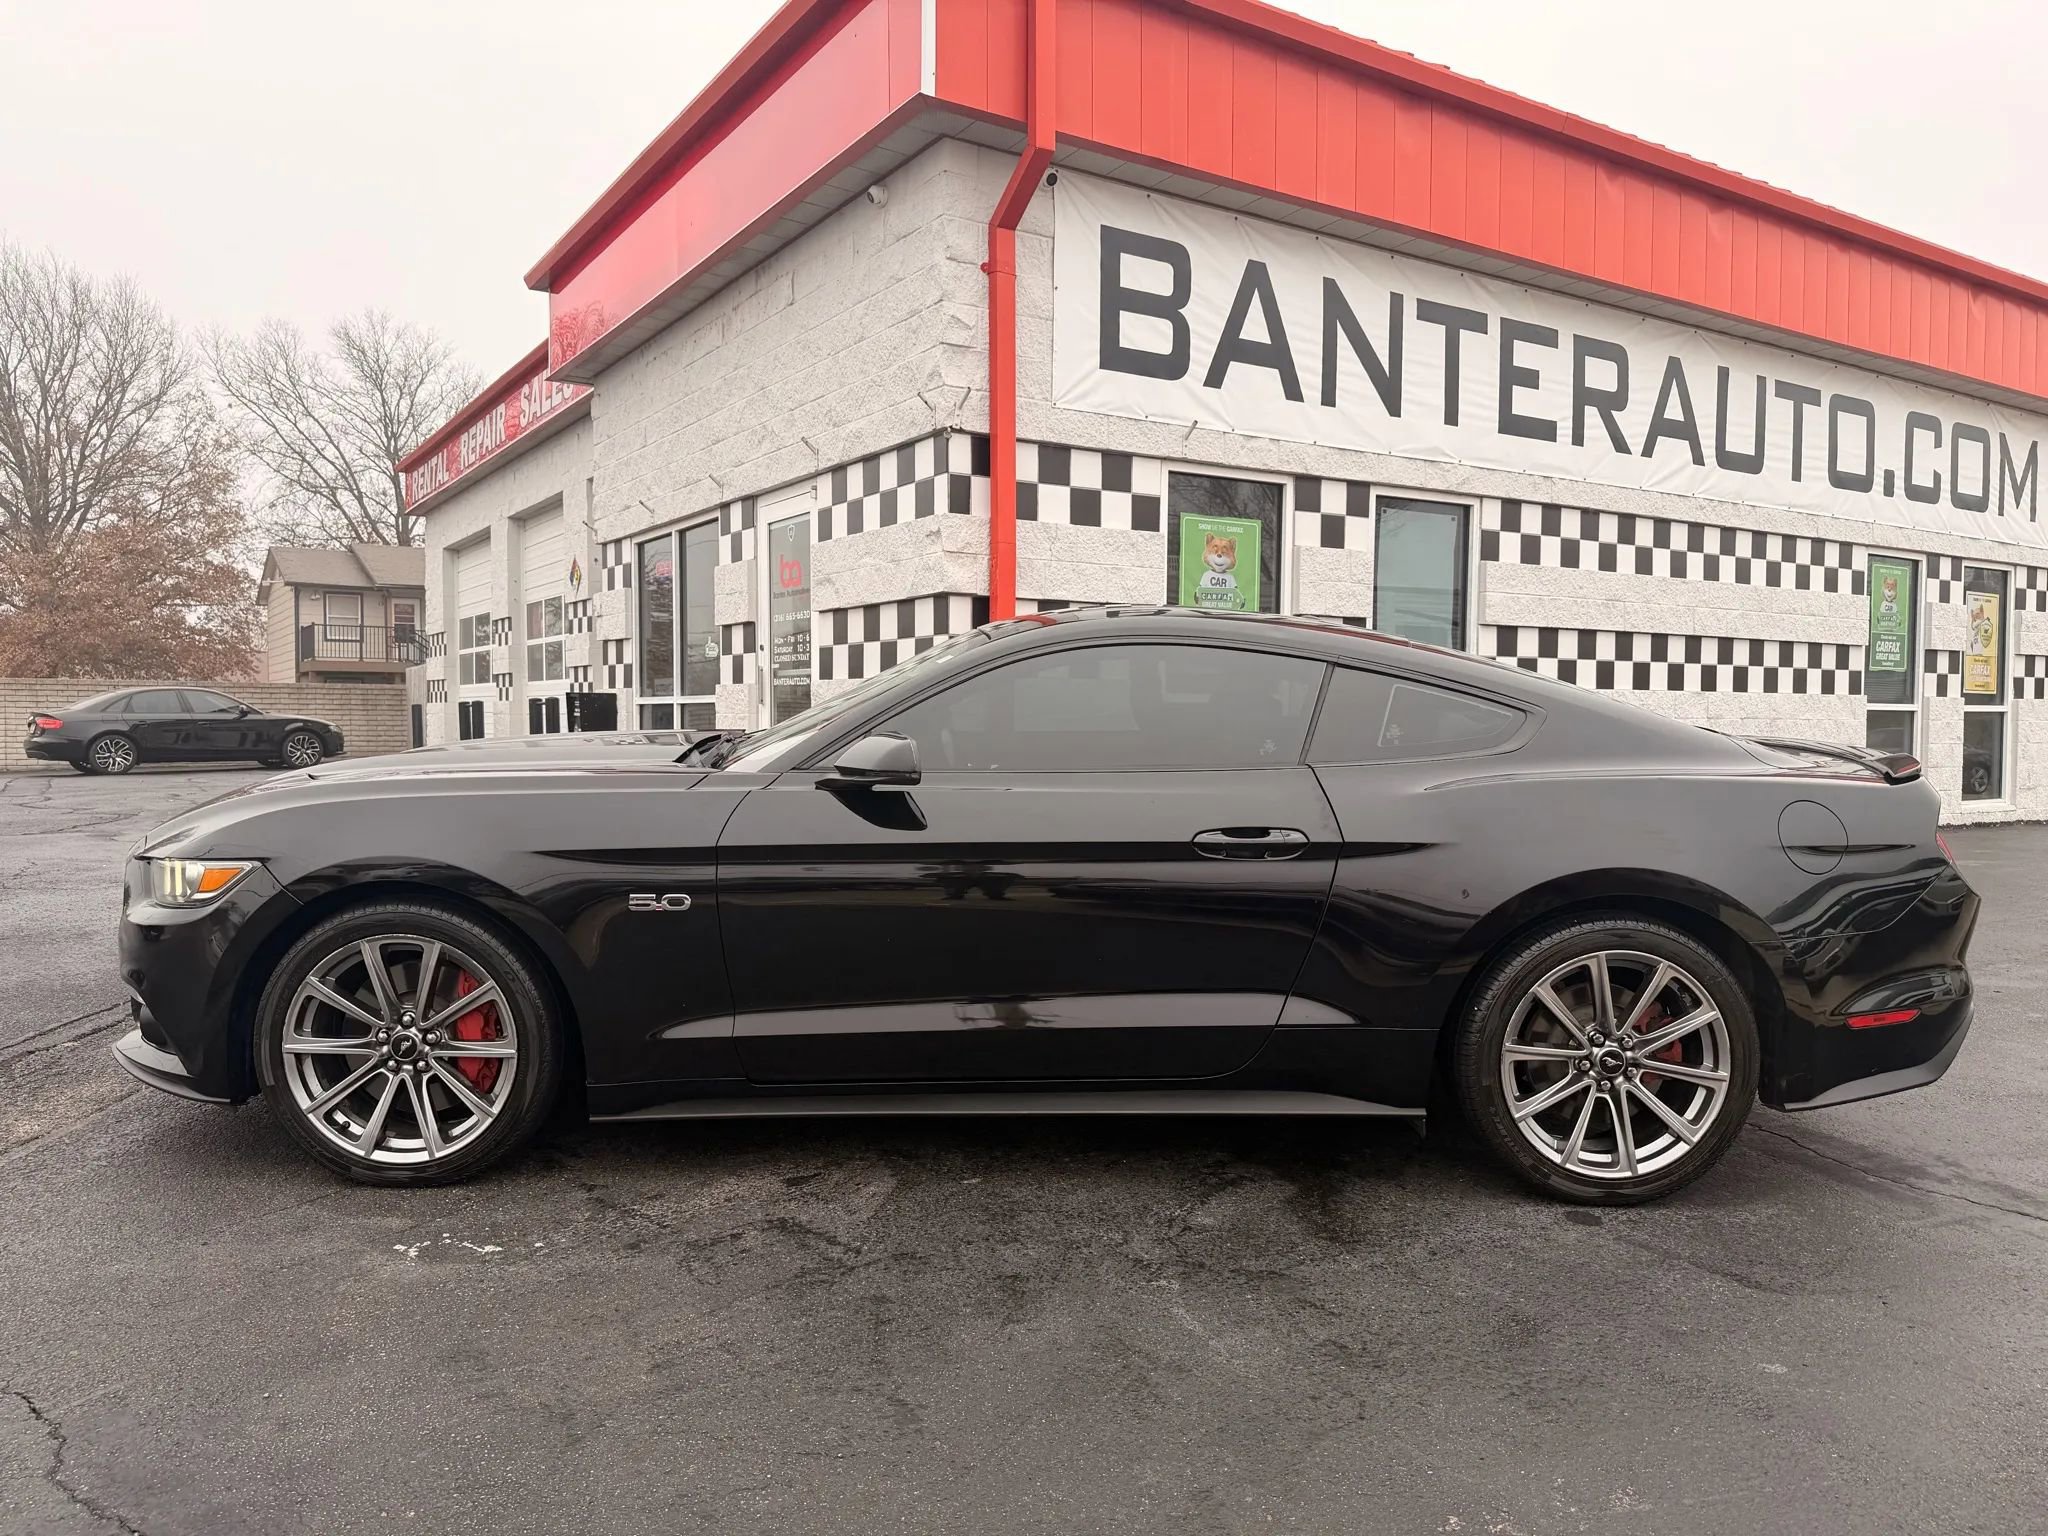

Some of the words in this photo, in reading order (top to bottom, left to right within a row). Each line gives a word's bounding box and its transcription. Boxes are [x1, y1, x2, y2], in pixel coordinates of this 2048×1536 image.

[1100, 224, 2038, 521] BANTERAUTO.COM
[412, 448, 449, 502] RENTAL
[460, 403, 506, 471] REPAIR
[1210, 576, 1227, 587] CAR
[1875, 640, 1901, 653] CARFAX
[628, 893, 691, 911] 5.0
